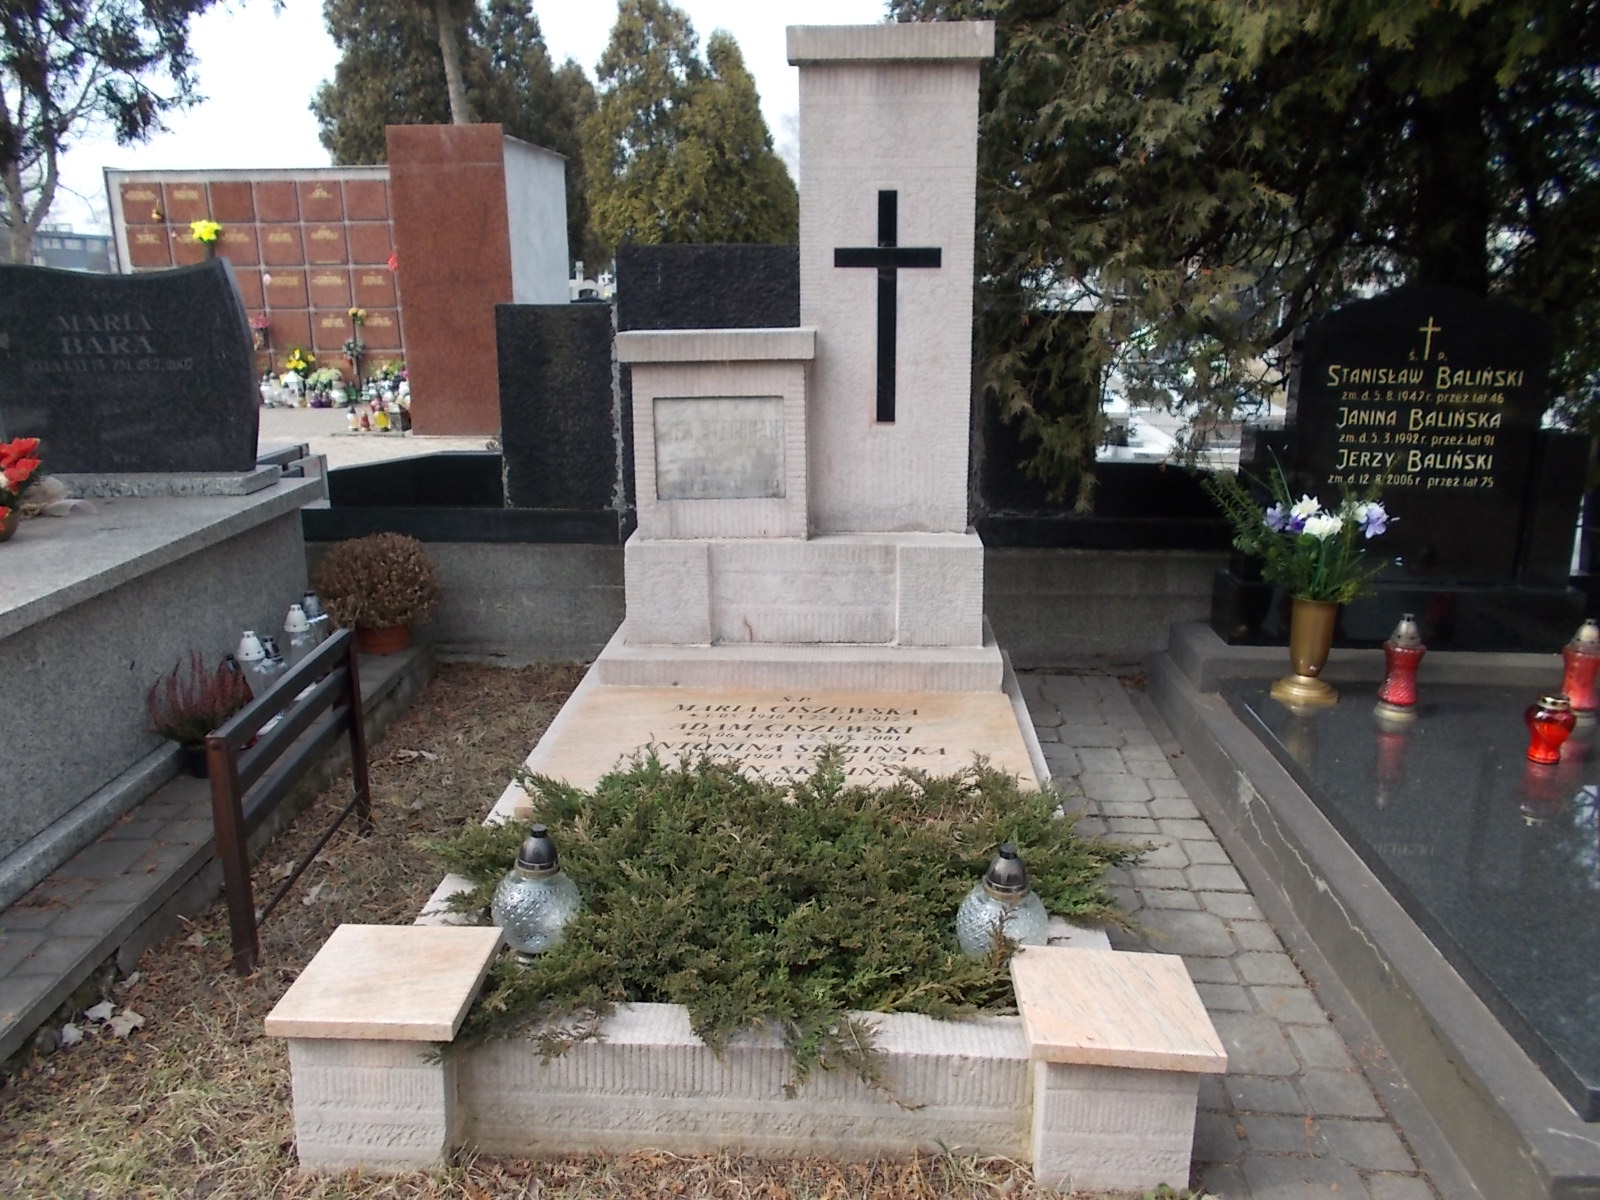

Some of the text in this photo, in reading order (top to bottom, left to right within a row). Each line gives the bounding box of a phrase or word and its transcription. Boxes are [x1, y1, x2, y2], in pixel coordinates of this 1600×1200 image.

[58, 314, 152, 331] MARIA
[61, 336, 155, 354] BARA
[1327, 364, 1525, 389] STANISŁAW BALIŃSKI
[1398, 390, 1425, 403] 1947
[1472, 393, 1488, 404] lat
[1488, 393, 1505, 404] 46
[1336, 407, 1502, 431] JANINA BALIŃSKA
[1394, 432, 1420, 445] 1992
[1467, 433, 1482, 446] lat
[1483, 435, 1496, 447] 91
[1336, 449, 1494, 472] JERZY BALIŃSKI
[1386, 473, 1414, 486] 2006
[1463, 476, 1479, 488] lat
[1481, 476, 1494, 489] 75
[672, 704, 918, 716] MARIA CISZEWSKA
[670, 722, 912, 734] ADAM CISZEWSKI
[637, 741, 946, 755] ANTONINA SKBIŃSKA
